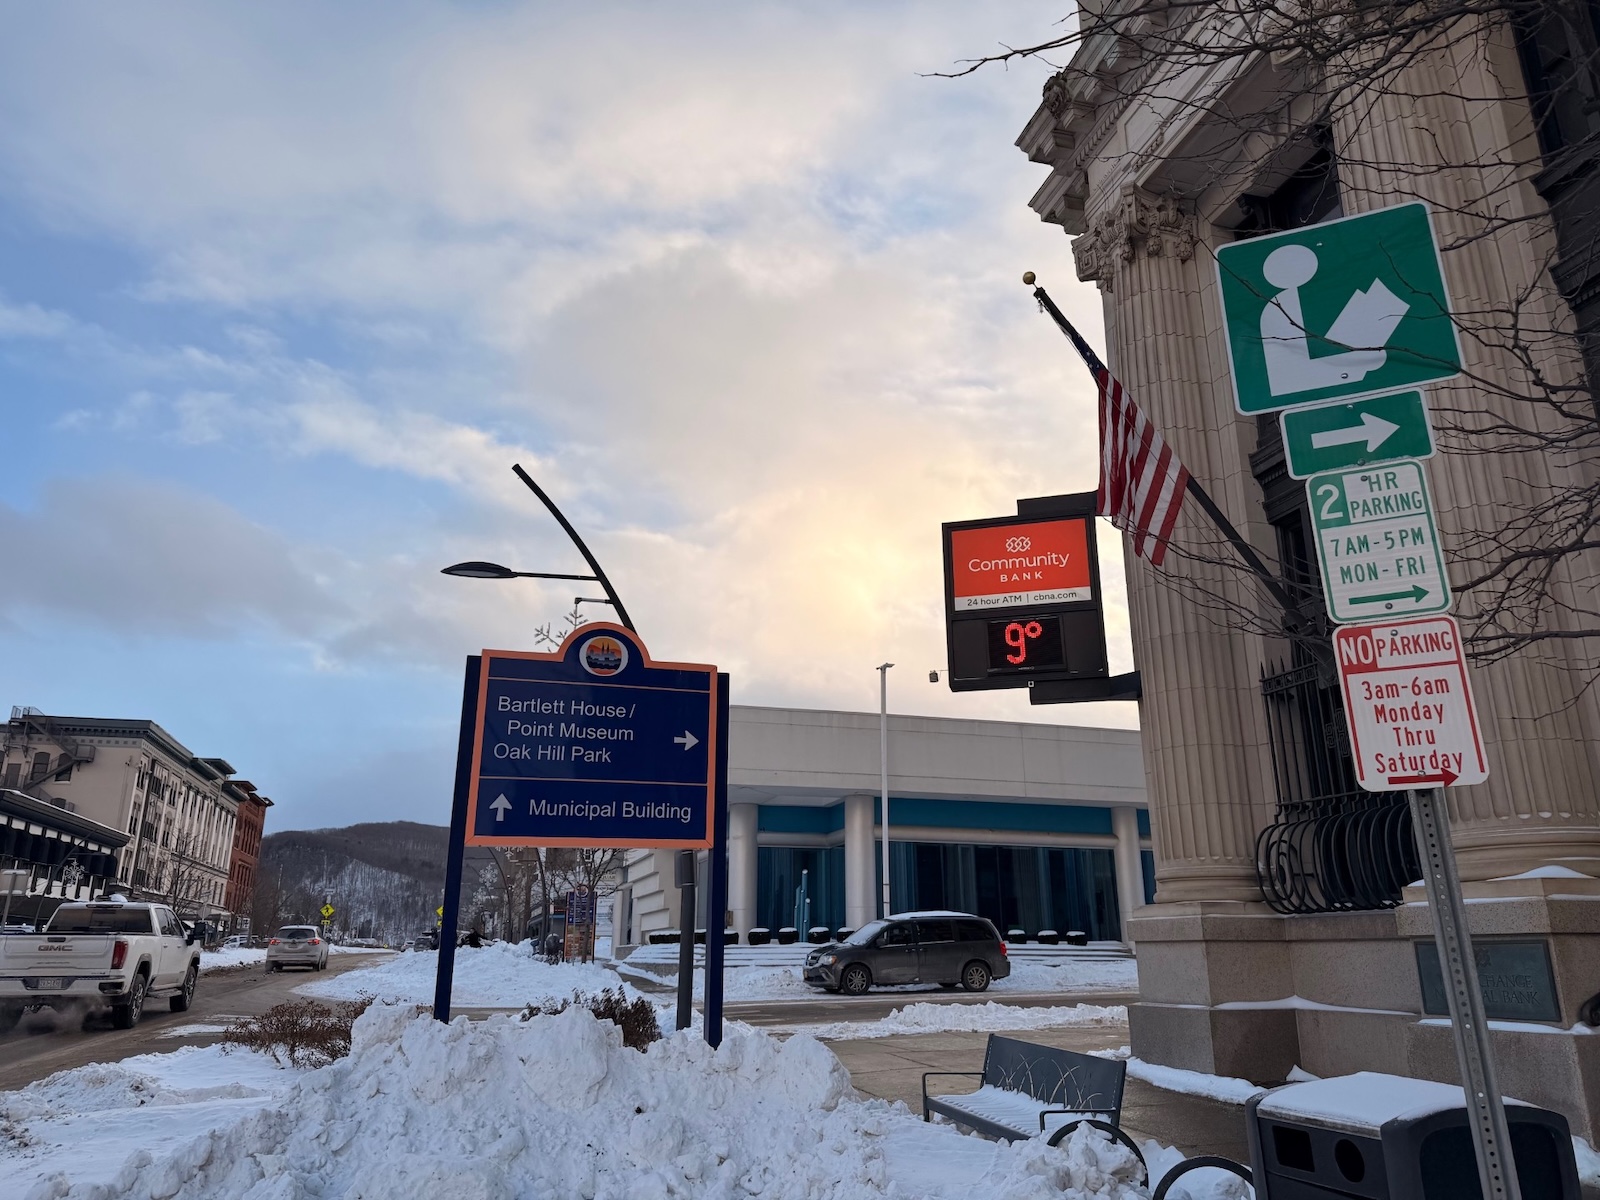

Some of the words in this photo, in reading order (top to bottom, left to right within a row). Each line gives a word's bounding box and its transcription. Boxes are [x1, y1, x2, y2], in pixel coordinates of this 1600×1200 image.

[1316, 484, 1344, 521] 2
[1368, 471, 1399, 493] HR
[1350, 491, 1423, 519] PARKING
[968, 552, 1070, 573] Community
[1000, 571, 1043, 583] BANK
[967, 598, 979, 607] 24
[980, 597, 1000, 606] hour
[1002, 595, 1022, 604] ATM
[1033, 591, 1077, 601] cbna.com
[1339, 635, 1374, 666] NO
[1376, 631, 1453, 658] PARKING
[1361, 676, 1450, 701] 3am-6am
[498, 696, 565, 715] Bartlett
[1374, 701, 1444, 724] Monday
[507, 720, 554, 738] Point
[559, 722, 634, 741] Museum
[1392, 727, 1436, 747] Thru
[493, 743, 531, 760] Oak
[537, 745, 565, 761] Hill
[571, 746, 612, 763] Park
[1374, 749, 1463, 774] Saturday
[529, 799, 616, 820] Municipal
[622, 801, 692, 823] Building
[1503, 990, 1541, 1006] BANK
